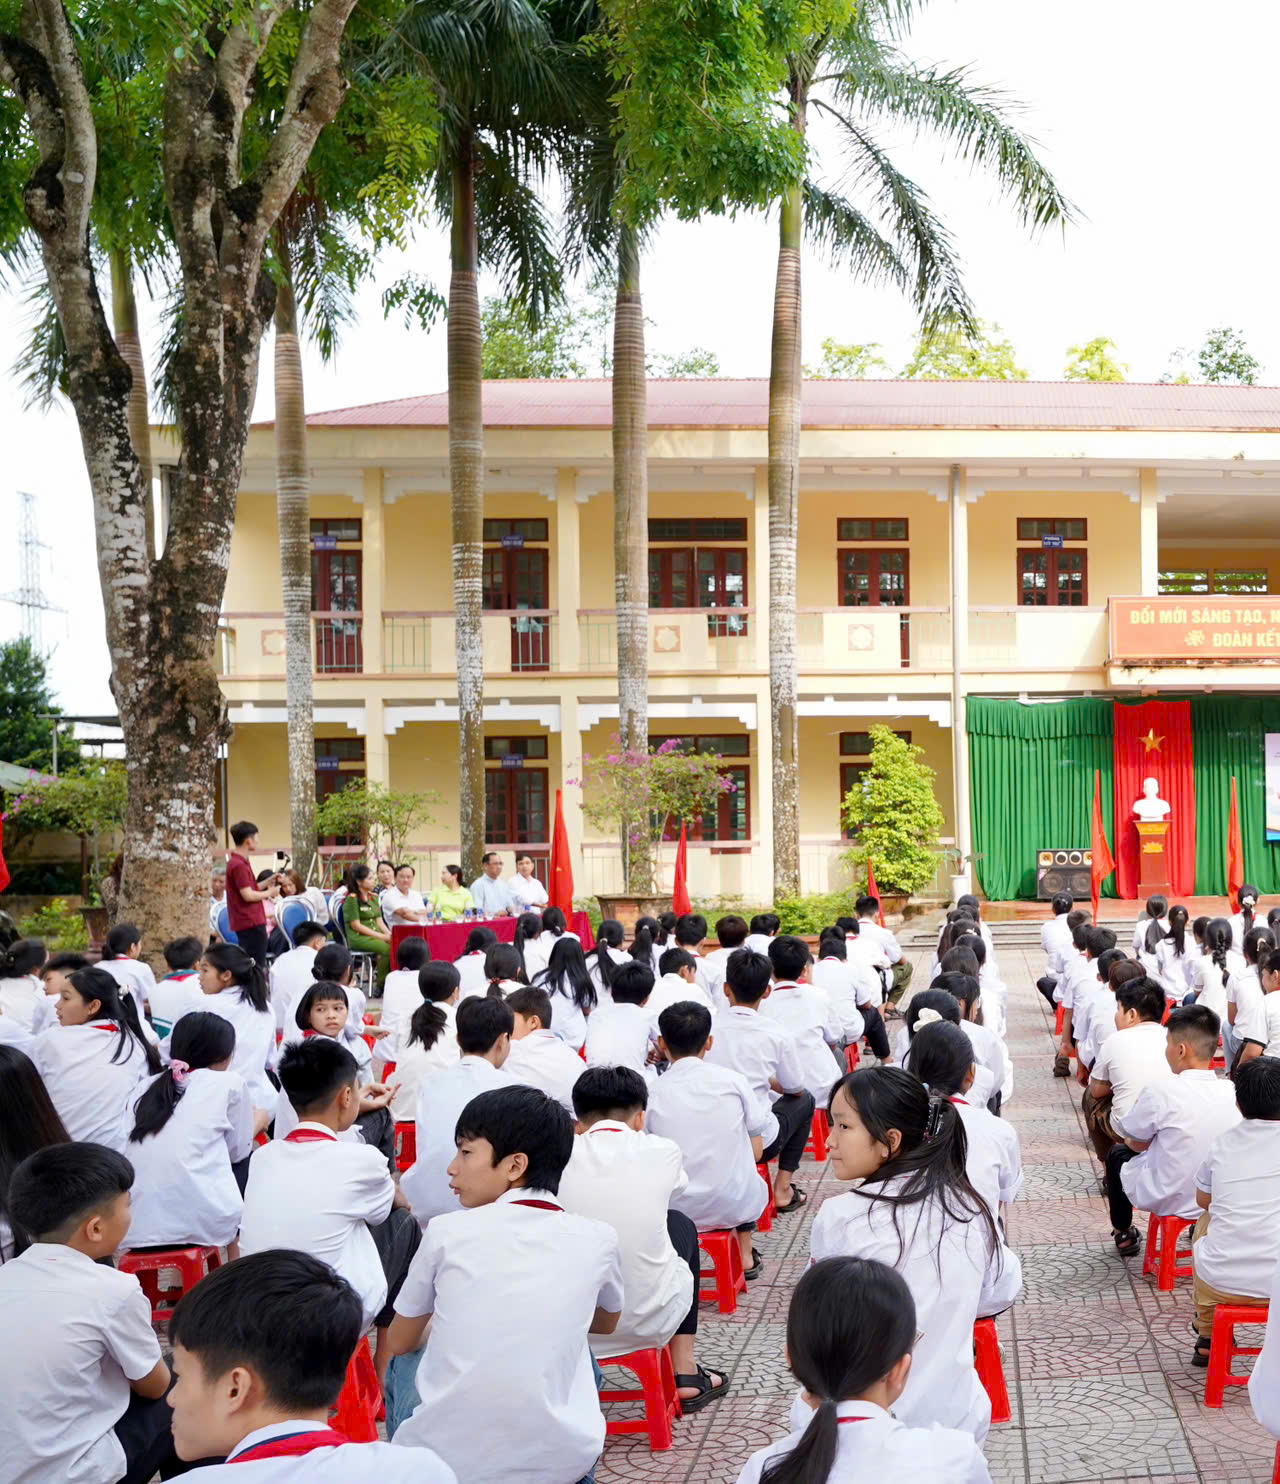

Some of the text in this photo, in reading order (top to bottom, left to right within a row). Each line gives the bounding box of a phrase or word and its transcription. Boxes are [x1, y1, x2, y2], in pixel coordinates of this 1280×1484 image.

[1130, 605, 1155, 624] ĐỔI
[1159, 606, 1187, 624] MỚI
[1191, 607, 1232, 624] SÁNG
[1234, 609, 1267, 626] TẠO,
[1212, 629, 1253, 647] ĐOÀN
